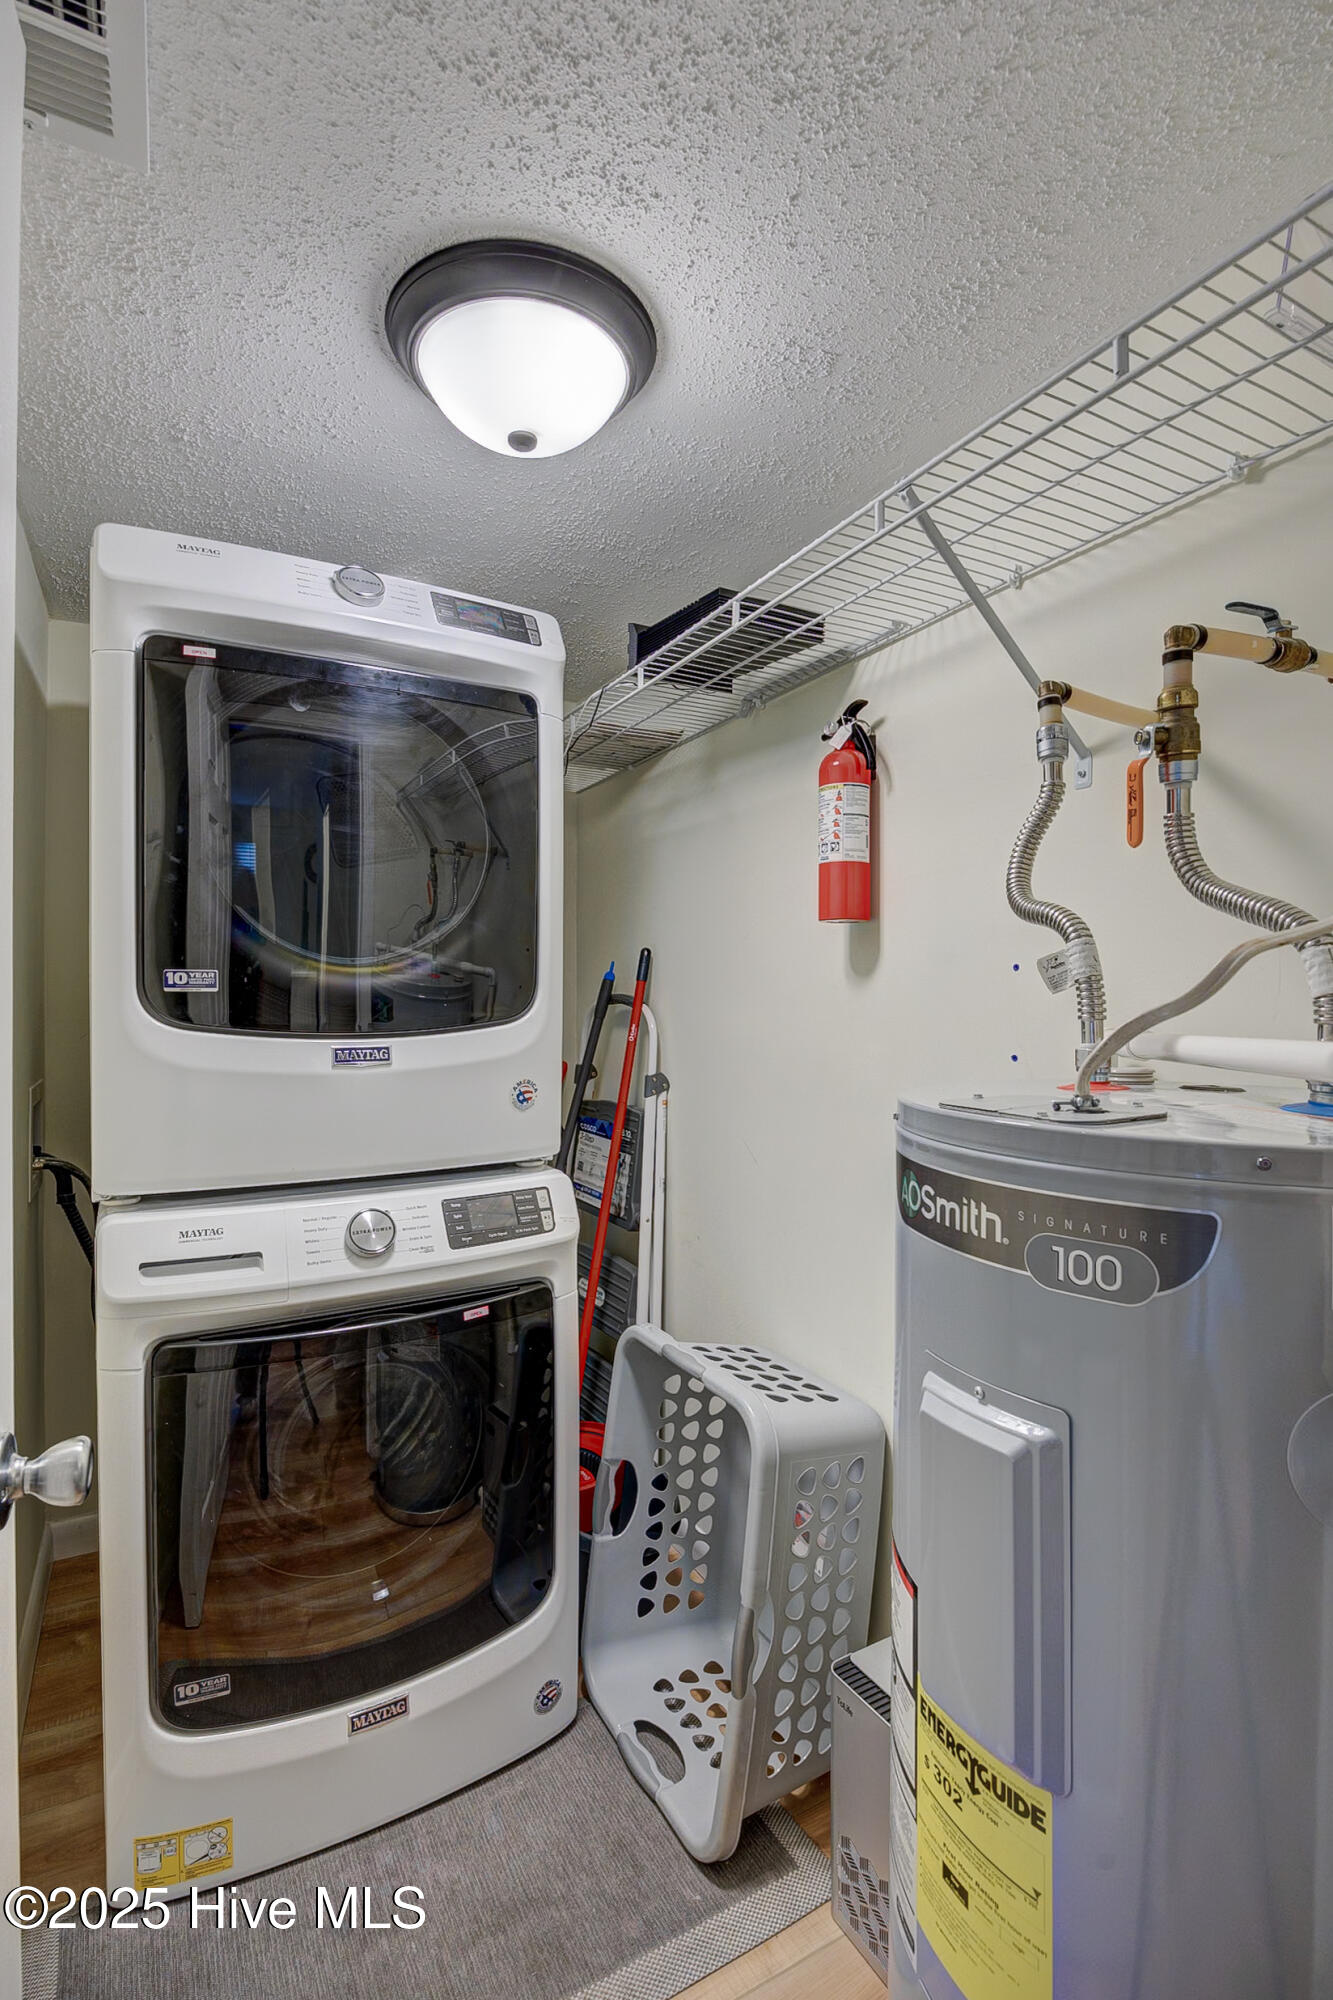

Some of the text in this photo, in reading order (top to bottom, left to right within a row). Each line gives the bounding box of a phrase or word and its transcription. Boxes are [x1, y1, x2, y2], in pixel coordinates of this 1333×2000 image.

[176, 543, 221, 555] MAYTAG
[166, 971, 188, 985] 10
[336, 1048, 390, 1061] MAYTAG
[178, 1227, 224, 1239] MAYTAG
[1017, 1209, 1168, 1245] SIGNATURE
[1051, 1245, 1123, 1292] 100
[201, 1676, 227, 1687] YEAR
[177, 1683, 200, 1699] 10
[352, 1700, 406, 1729] MAYTAG
[933, 1763, 963, 1812] 302
